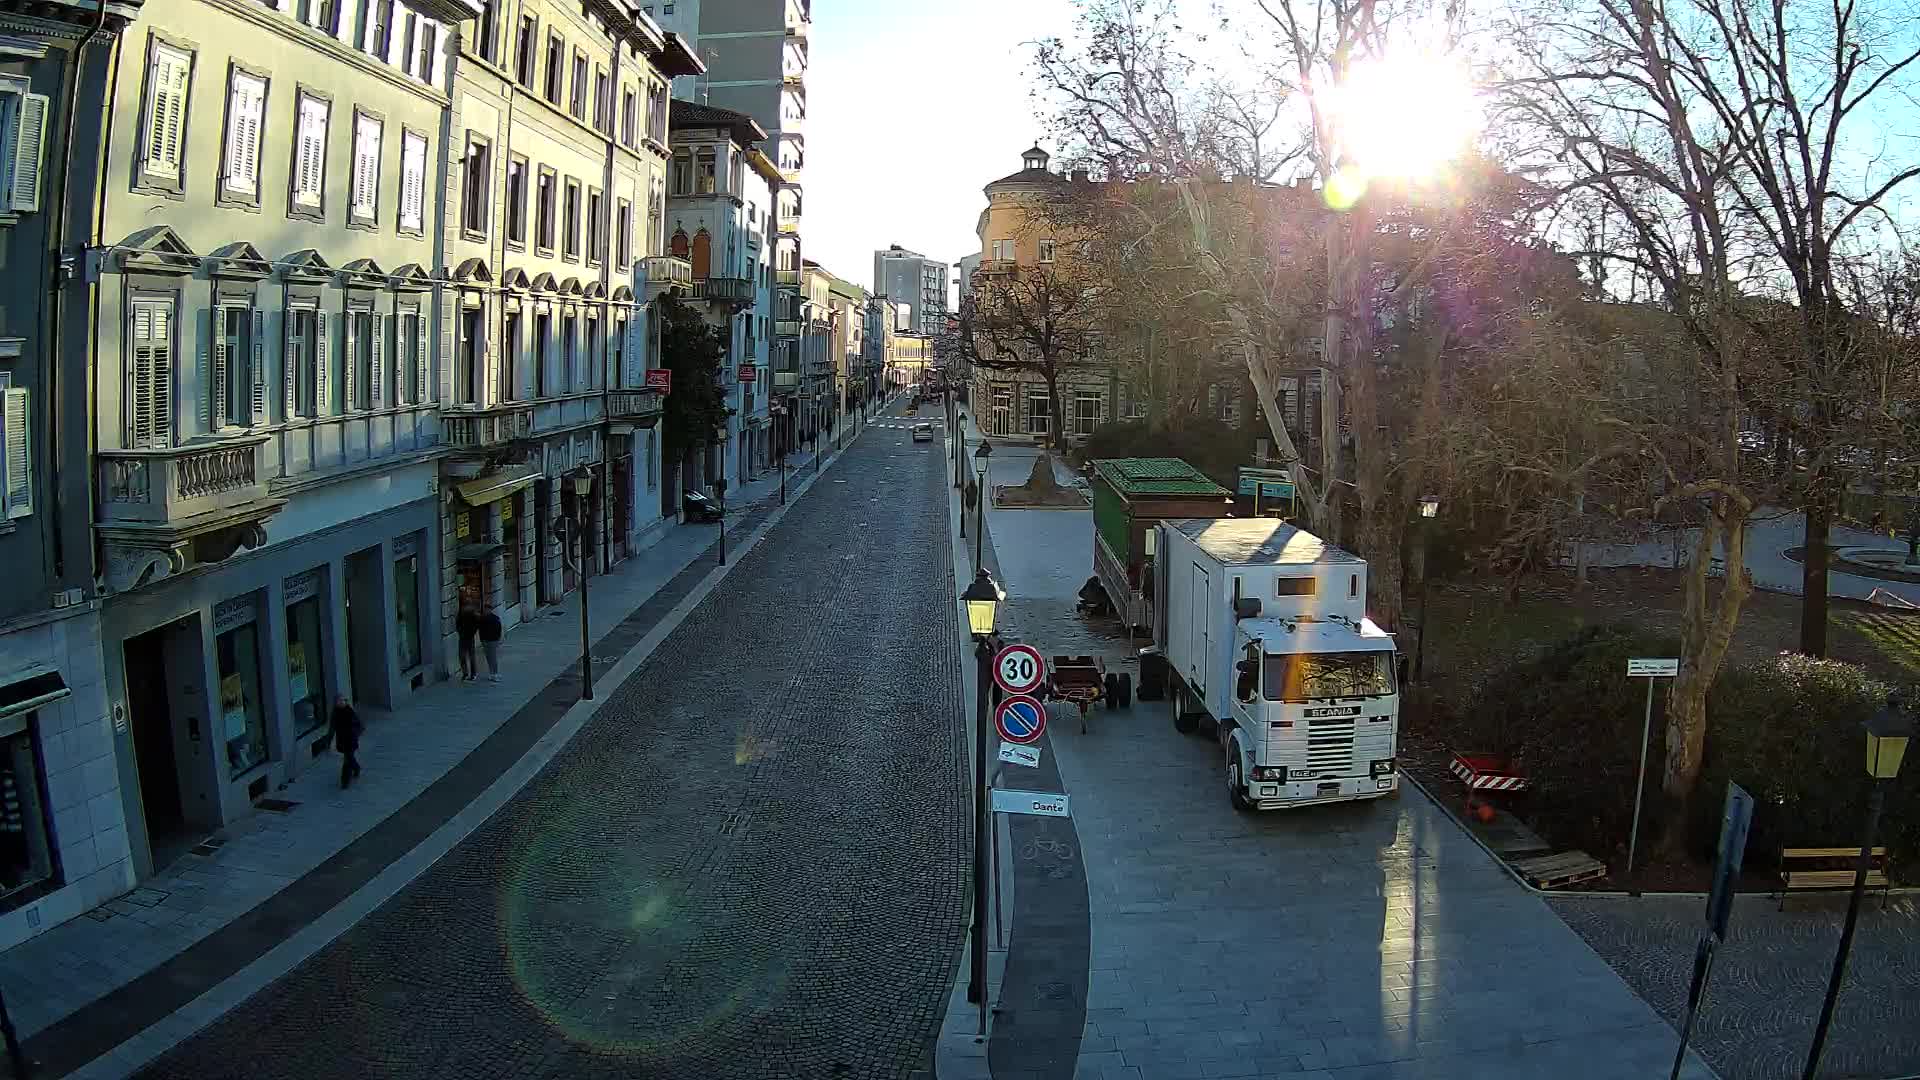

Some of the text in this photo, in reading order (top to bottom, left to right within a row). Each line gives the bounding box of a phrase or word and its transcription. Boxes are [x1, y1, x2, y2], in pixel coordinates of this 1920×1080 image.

[1005, 657, 1034, 681] 30
[1311, 707, 1354, 717] SCANIA
[1032, 801, 1064, 812] Dante
